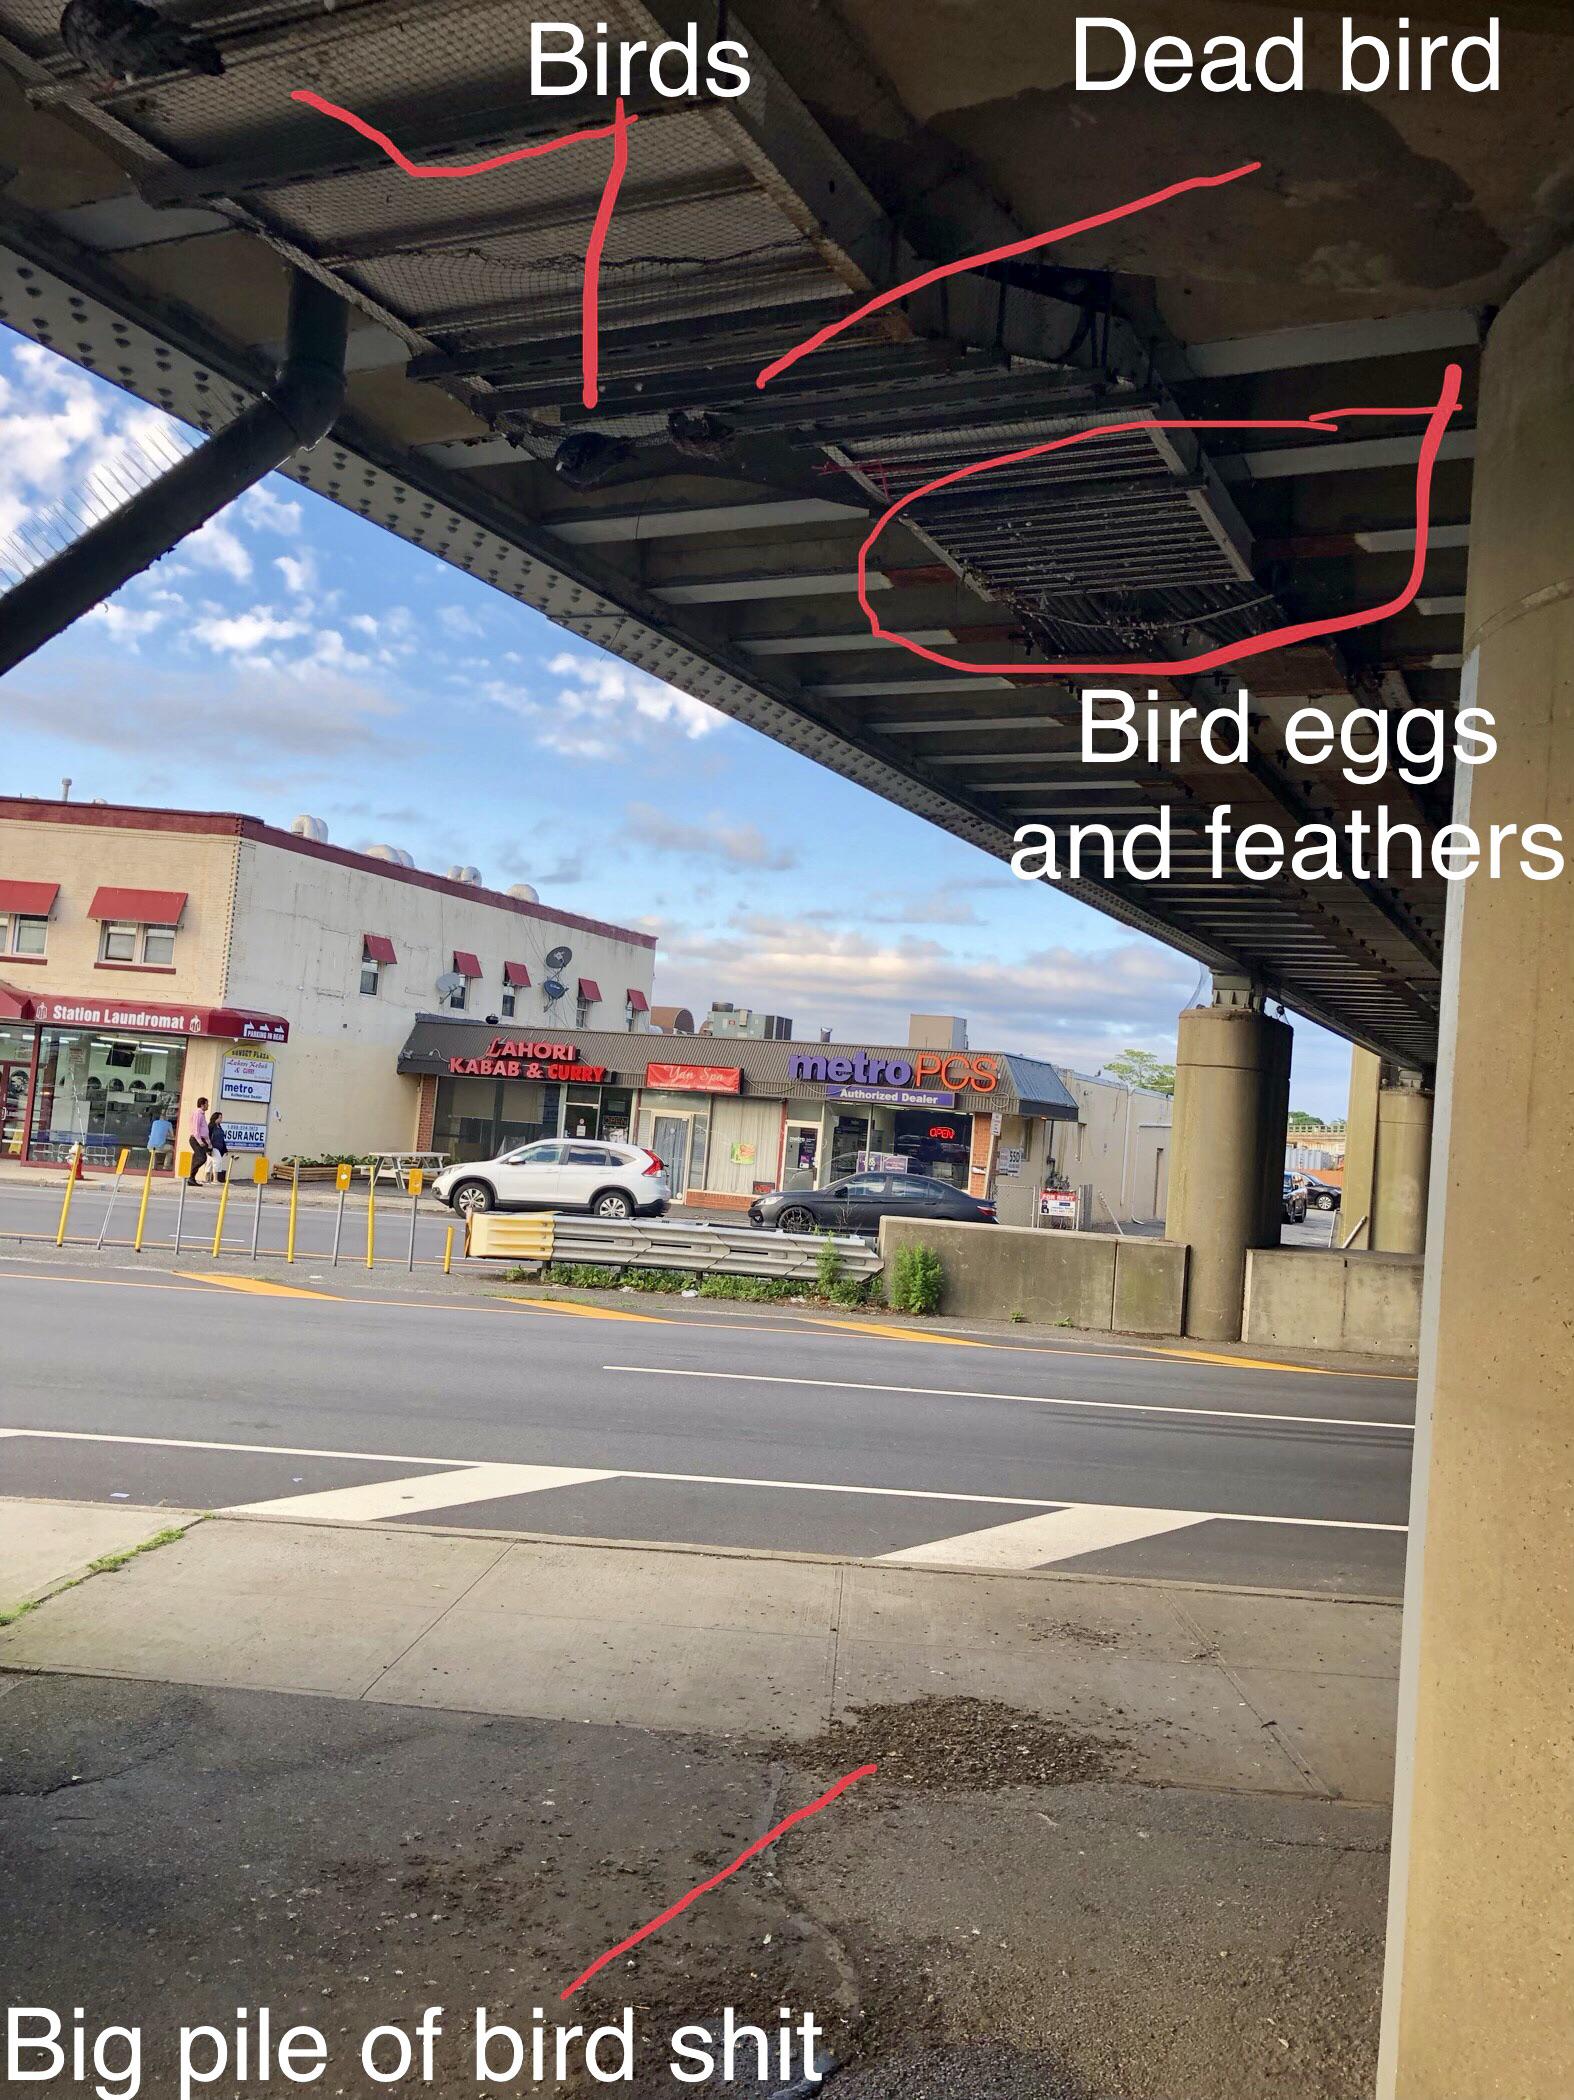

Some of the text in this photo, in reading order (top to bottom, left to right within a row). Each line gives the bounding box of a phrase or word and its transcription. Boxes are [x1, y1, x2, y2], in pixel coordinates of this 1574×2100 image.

[53, 1005, 184, 1030] Station Laundromat
[247, 1030, 266, 1039] PARKING
[485, 1035, 576, 1060] LAHORI
[450, 1057, 605, 1082] KABAB & CURRY
[699, 1066, 725, 1084] Spa
[225, 1084, 253, 1094] metro
[840, 1088, 939, 1105] Authorized Dealer
[929, 1128, 955, 1139] OPEN
